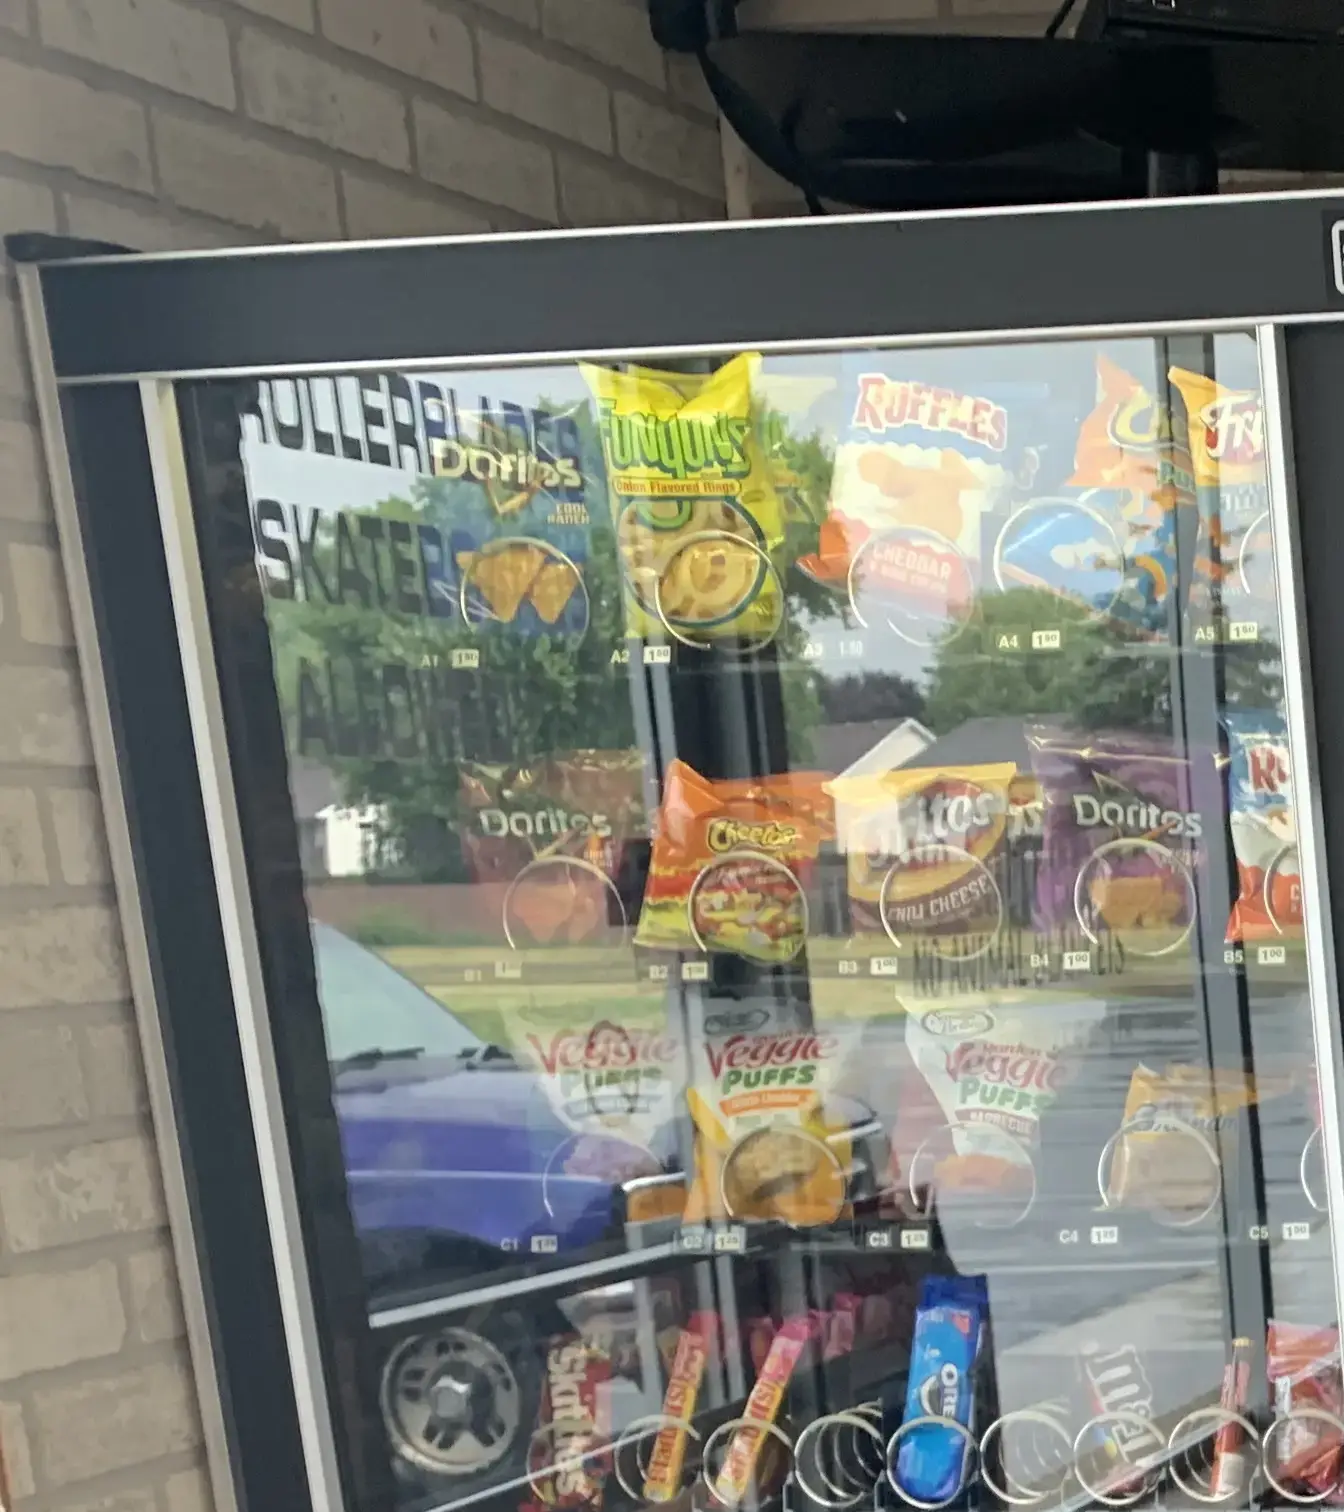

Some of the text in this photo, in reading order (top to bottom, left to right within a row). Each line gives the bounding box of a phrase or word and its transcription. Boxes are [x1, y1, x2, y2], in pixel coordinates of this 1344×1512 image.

[853, 373, 1007, 451] RUFFLES
[436, 437, 584, 488] Doritos
[615, 480, 736, 495] Onion Flavored Rings
[998, 634, 1018, 649] A4
[1194, 626, 1214, 641] A5
[479, 807, 612, 837] Doritos
[1073, 794, 1202, 838] Doritos
[1224, 949, 1244, 964] B5
[704, 1031, 840, 1082] Veggie
[723, 1065, 815, 1095] PUFFS
[1060, 1229, 1078, 1242] C4
